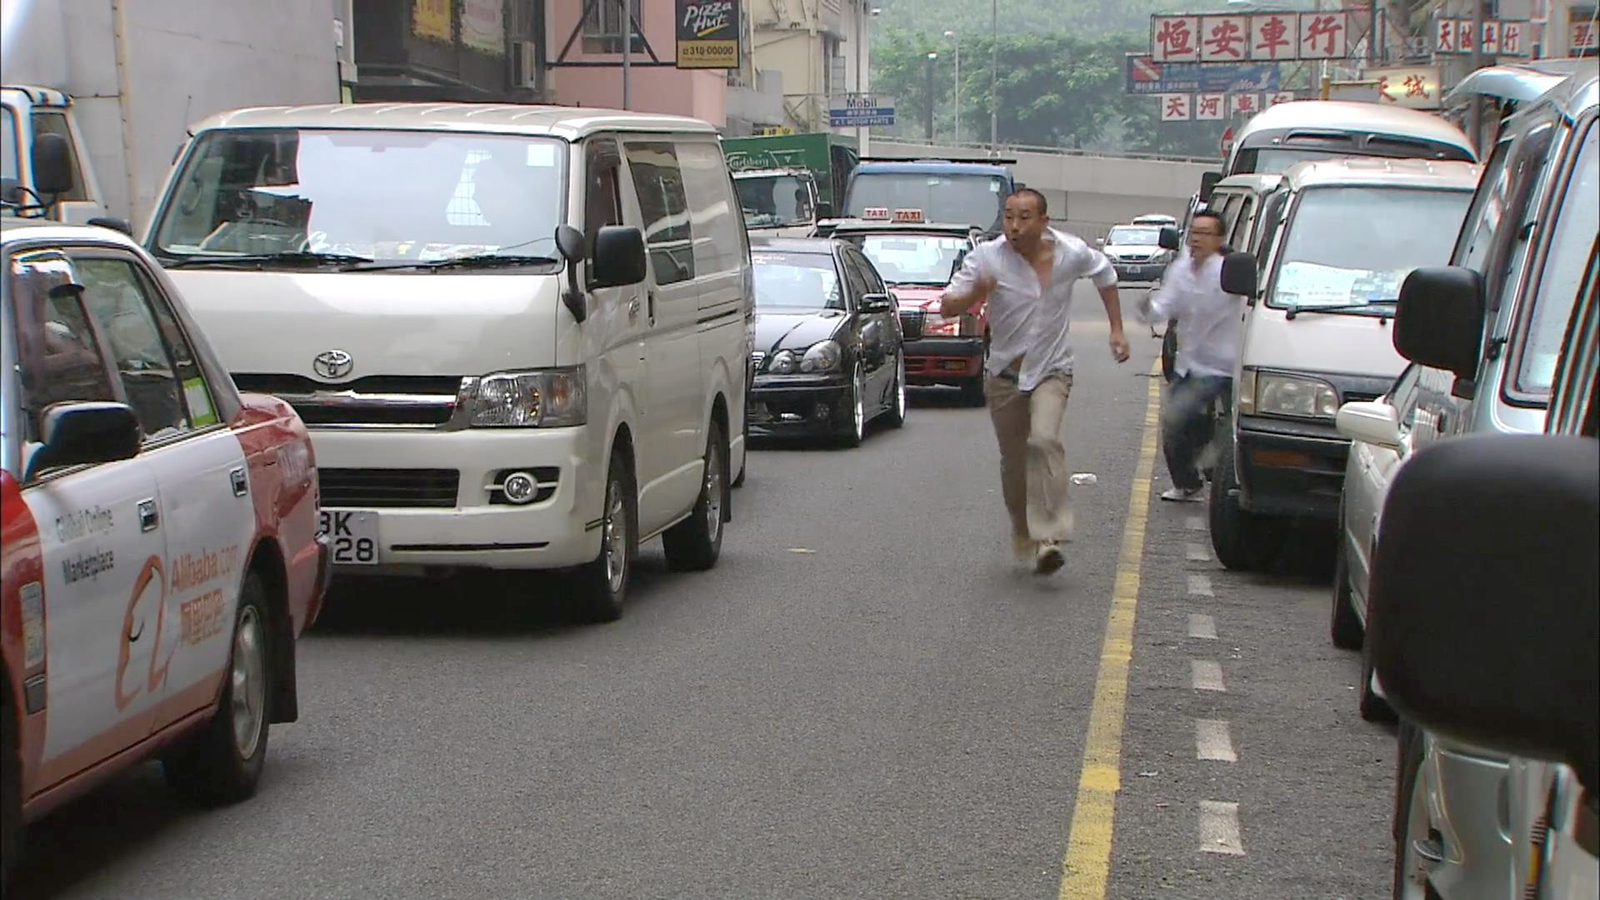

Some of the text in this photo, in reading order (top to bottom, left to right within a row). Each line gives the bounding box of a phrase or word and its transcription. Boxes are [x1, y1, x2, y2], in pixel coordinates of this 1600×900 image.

[683, 2, 733, 28] Pizza
[692, 13, 728, 33] Hut
[1157, 15, 1344, 58] 恒安車行
[846, 98, 878, 109] Mobil
[865, 209, 888, 218] TAXI
[895, 211, 921, 221] TAXI
